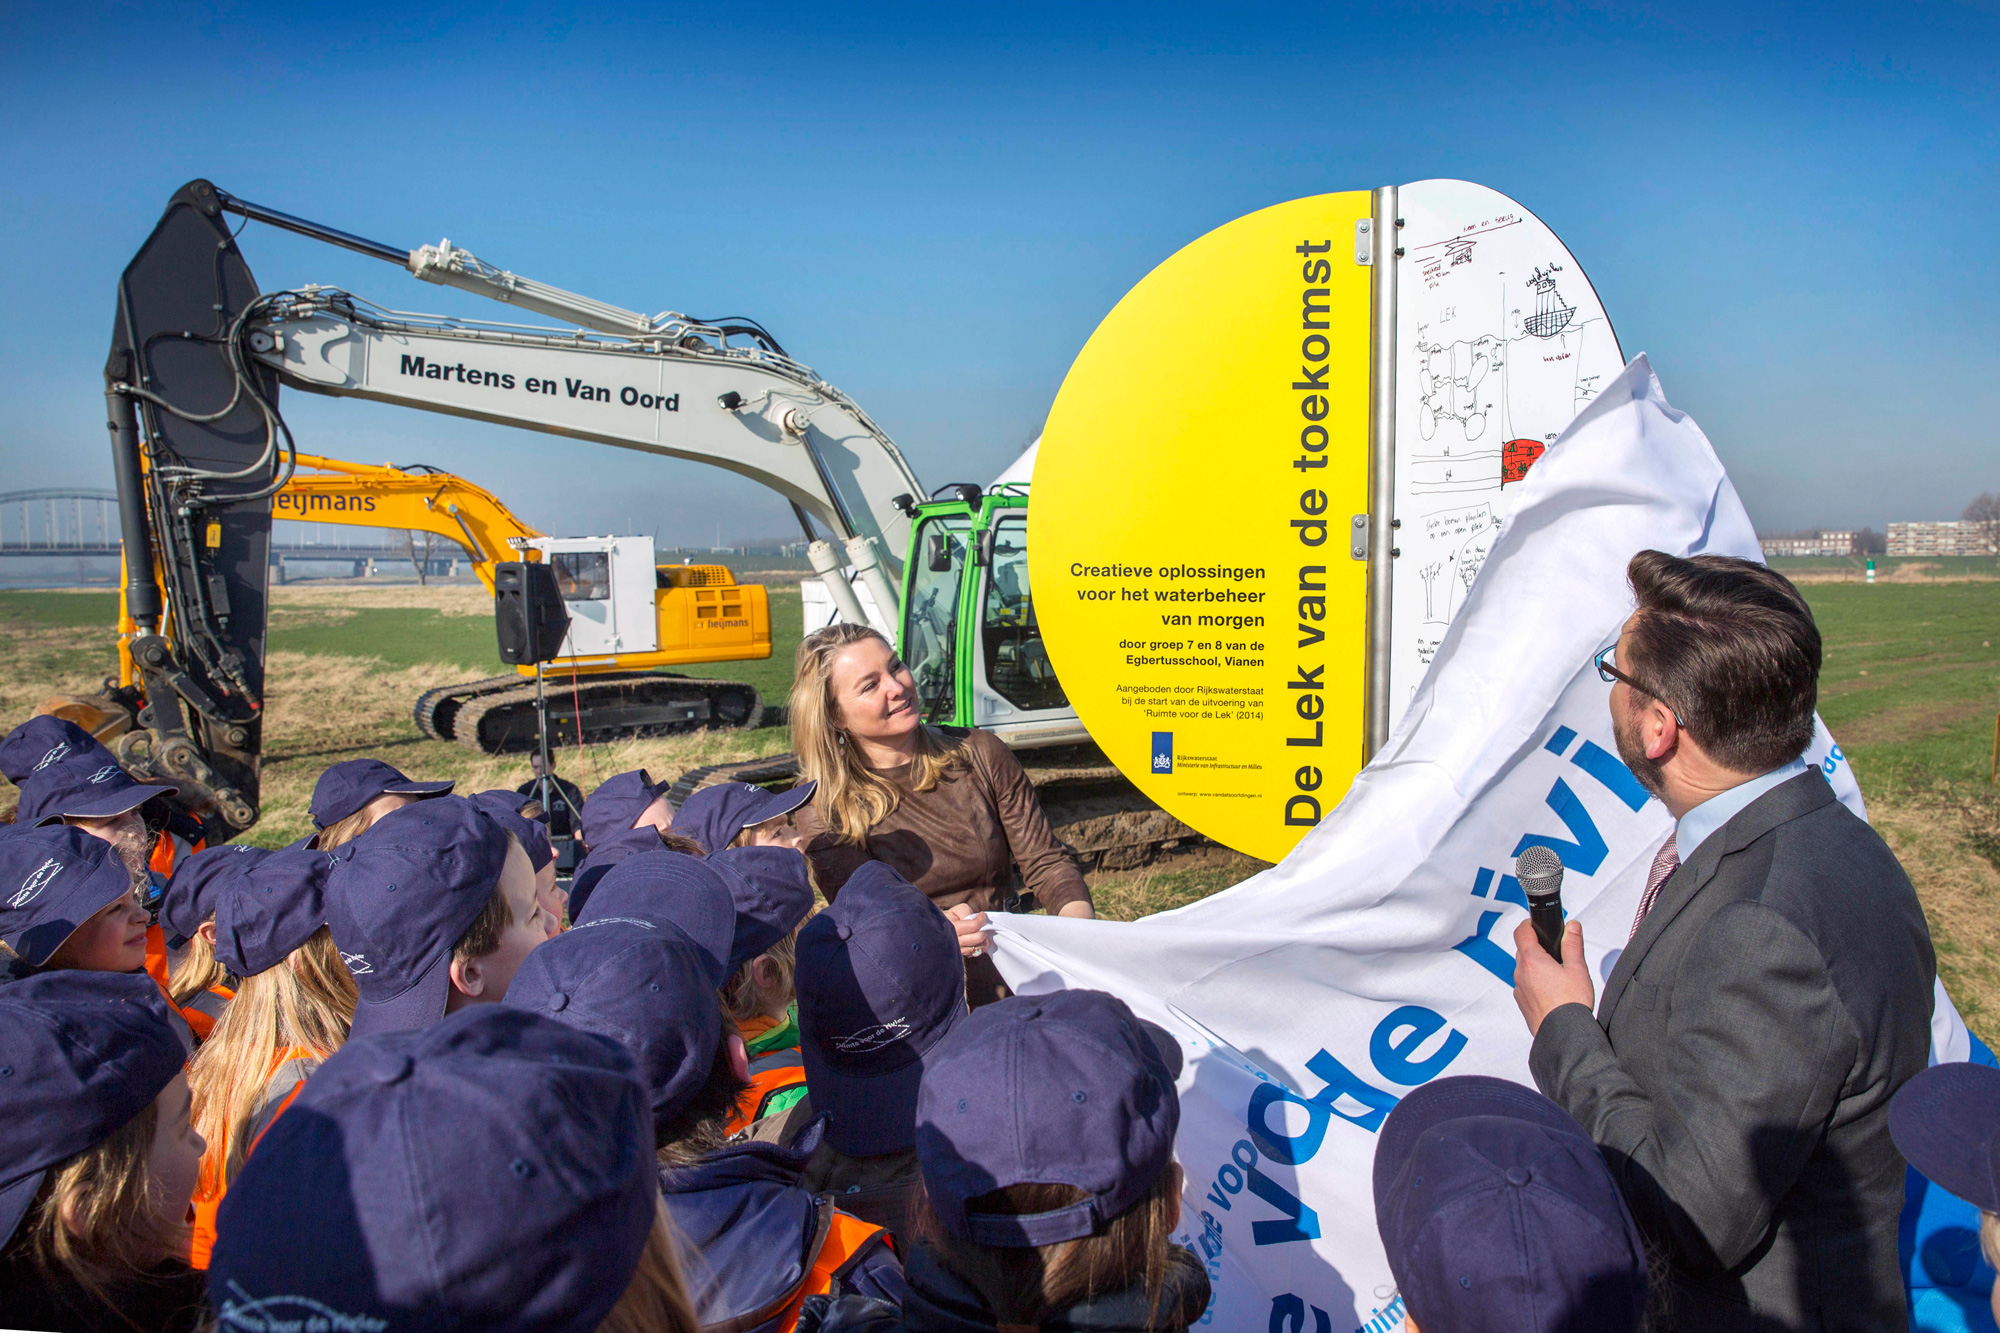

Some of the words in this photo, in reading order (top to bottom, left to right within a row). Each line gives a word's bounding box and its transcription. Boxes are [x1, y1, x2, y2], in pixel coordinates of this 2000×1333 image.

[1440, 306, 1457, 324] LEK
[1292, 239, 1332, 473] toekomst
[400, 354, 516, 390] Martens
[525, 377, 557, 395] en
[565, 378, 611, 403] Van
[620, 386, 680, 412] Oord
[272, 488, 376, 516] eijmans
[1290, 488, 1328, 547] de
[1071, 563, 1152, 577] Creatieve
[1159, 564, 1265, 581] oplossingen
[1077, 590, 1116, 600] voor
[1122, 587, 1149, 601] het
[1154, 588, 1265, 602] waterbeheer
[1298, 565, 1327, 649] van
[708, 618, 749, 630] heijmans
[1162, 615, 1191, 625] van
[1198, 616, 1264, 629] morgen
[1119, 639, 1146, 648] door
[1150, 642, 1183, 651] groep
[1188, 640, 1194, 649] 7
[1215, 641, 1222, 650] 8
[1250, 641, 1264, 650] de
[1127, 655, 1221, 667] Egbertusschool,
[1225, 657, 1264, 666] Vianen
[1116, 684, 1171, 694] Aangeboden
[1197, 686, 1263, 695] Rijkswaterstaat
[1122, 697, 1132, 706] bij
[1189, 698, 1199, 706] de
[1203, 699, 1245, 708] uitvoering
[1286, 664, 1325, 747] Lek
[1237, 711, 1263, 720] (2014)
[1285, 765, 1323, 826] De
